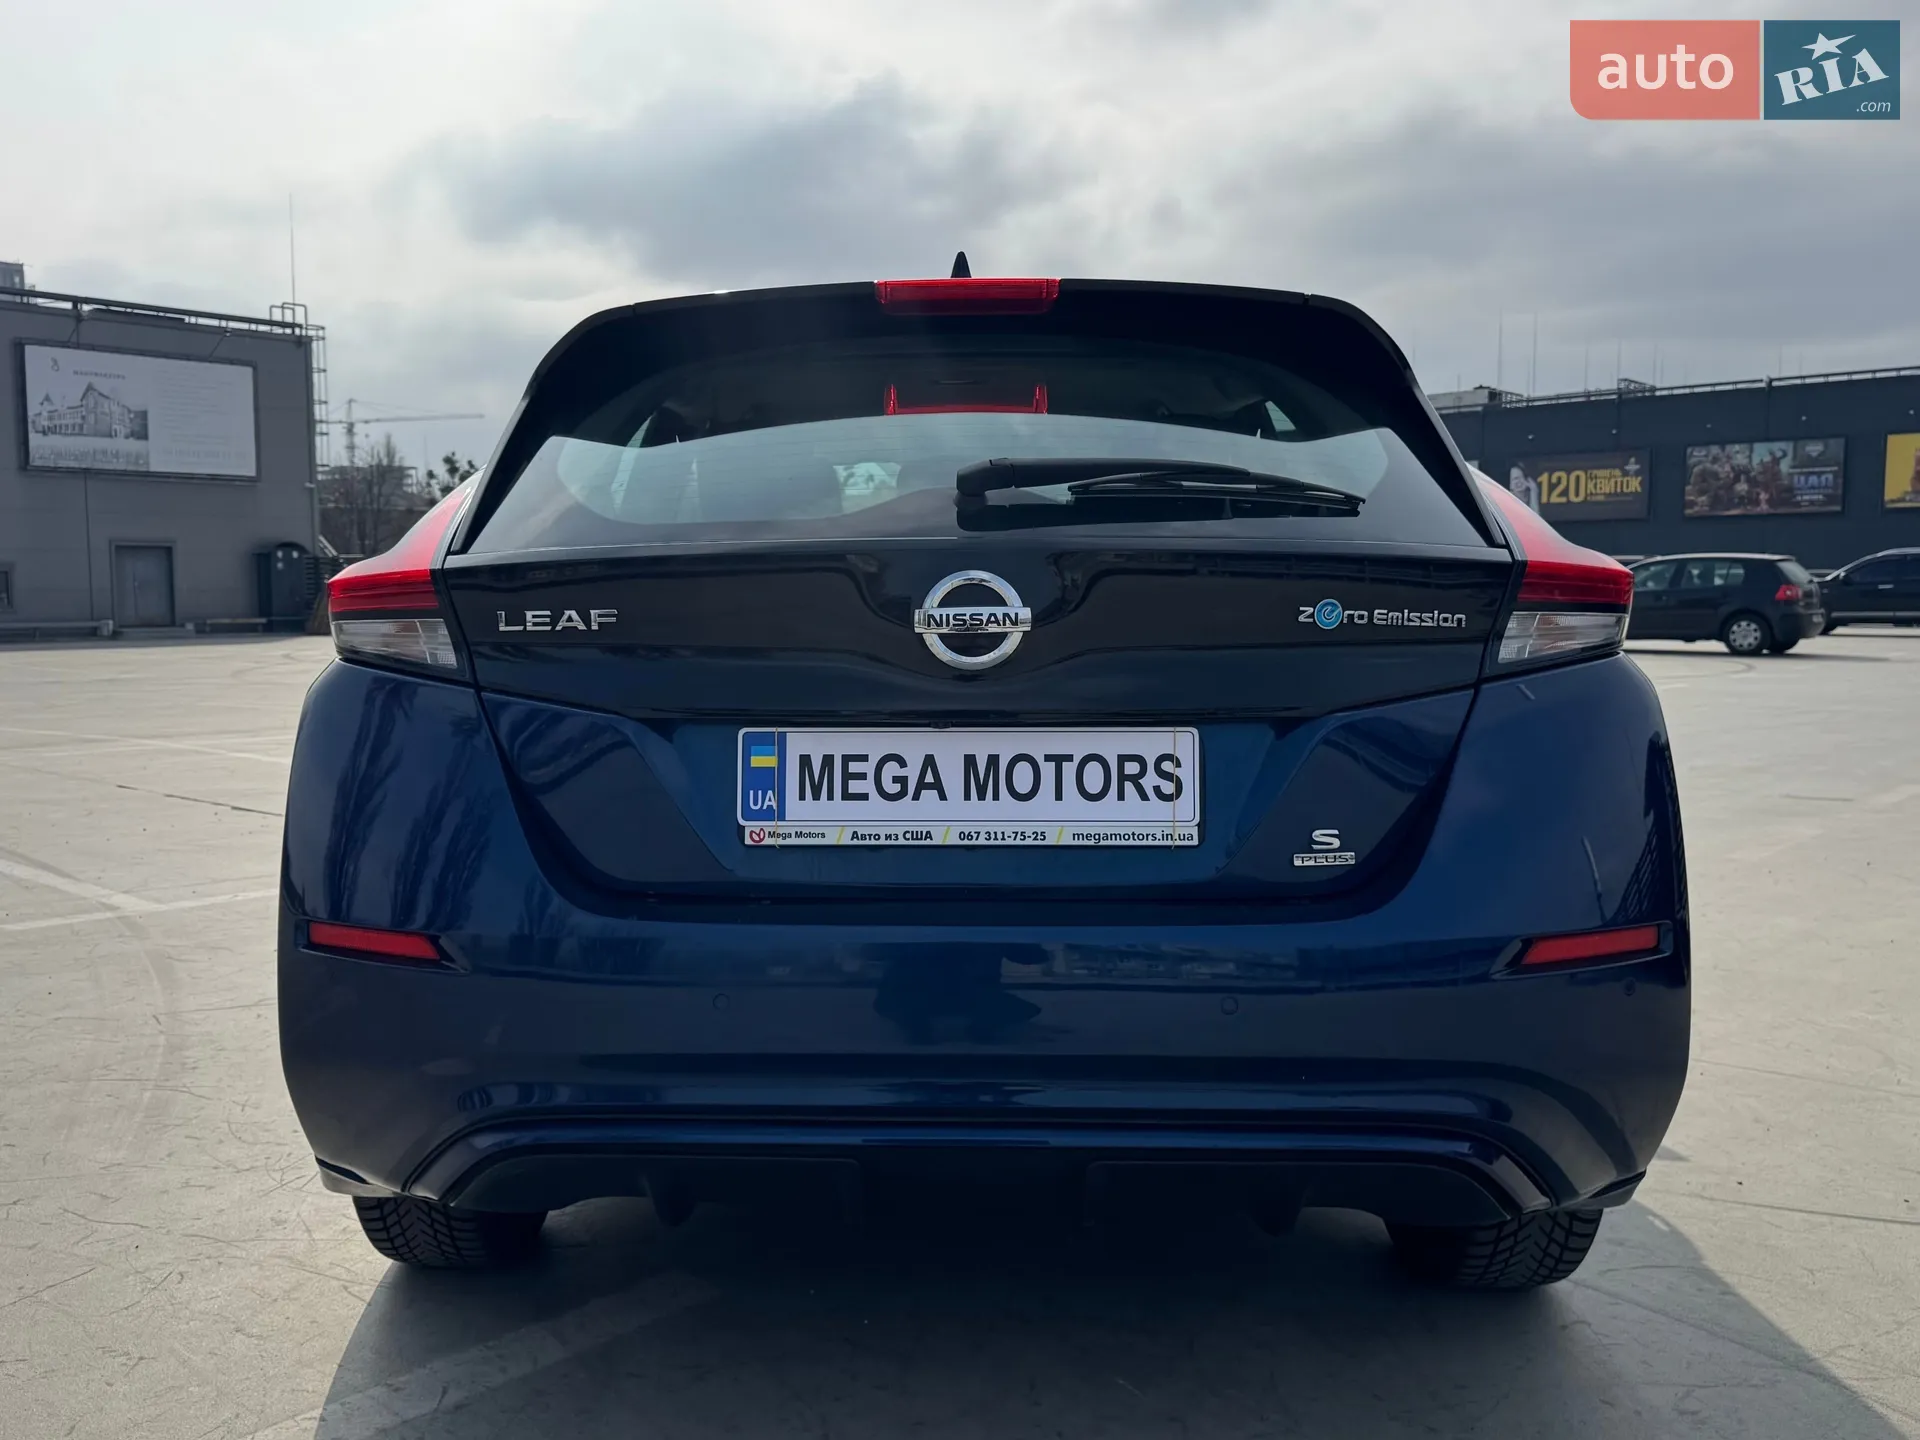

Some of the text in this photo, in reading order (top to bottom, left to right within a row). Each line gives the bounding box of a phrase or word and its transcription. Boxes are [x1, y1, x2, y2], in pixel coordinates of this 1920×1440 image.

[1537, 470, 1587, 504] 120
[1587, 476, 1642, 494] КВИТОК
[496, 609, 618, 632] LEAF
[926, 612, 1019, 628] NISSAN
[1373, 609, 1467, 628] Emission
[798, 752, 1184, 802] MEGA MOTORS
[749, 789, 777, 810] UA
[767, 830, 826, 840] Mega Motors
[850, 830, 934, 841] Авто из США
[958, 831, 1047, 841] 067 311-75-25
[1072, 830, 1194, 844] megamotors.in.ua
[1311, 828, 1341, 850] S
[1300, 854, 1349, 864] PLUS
